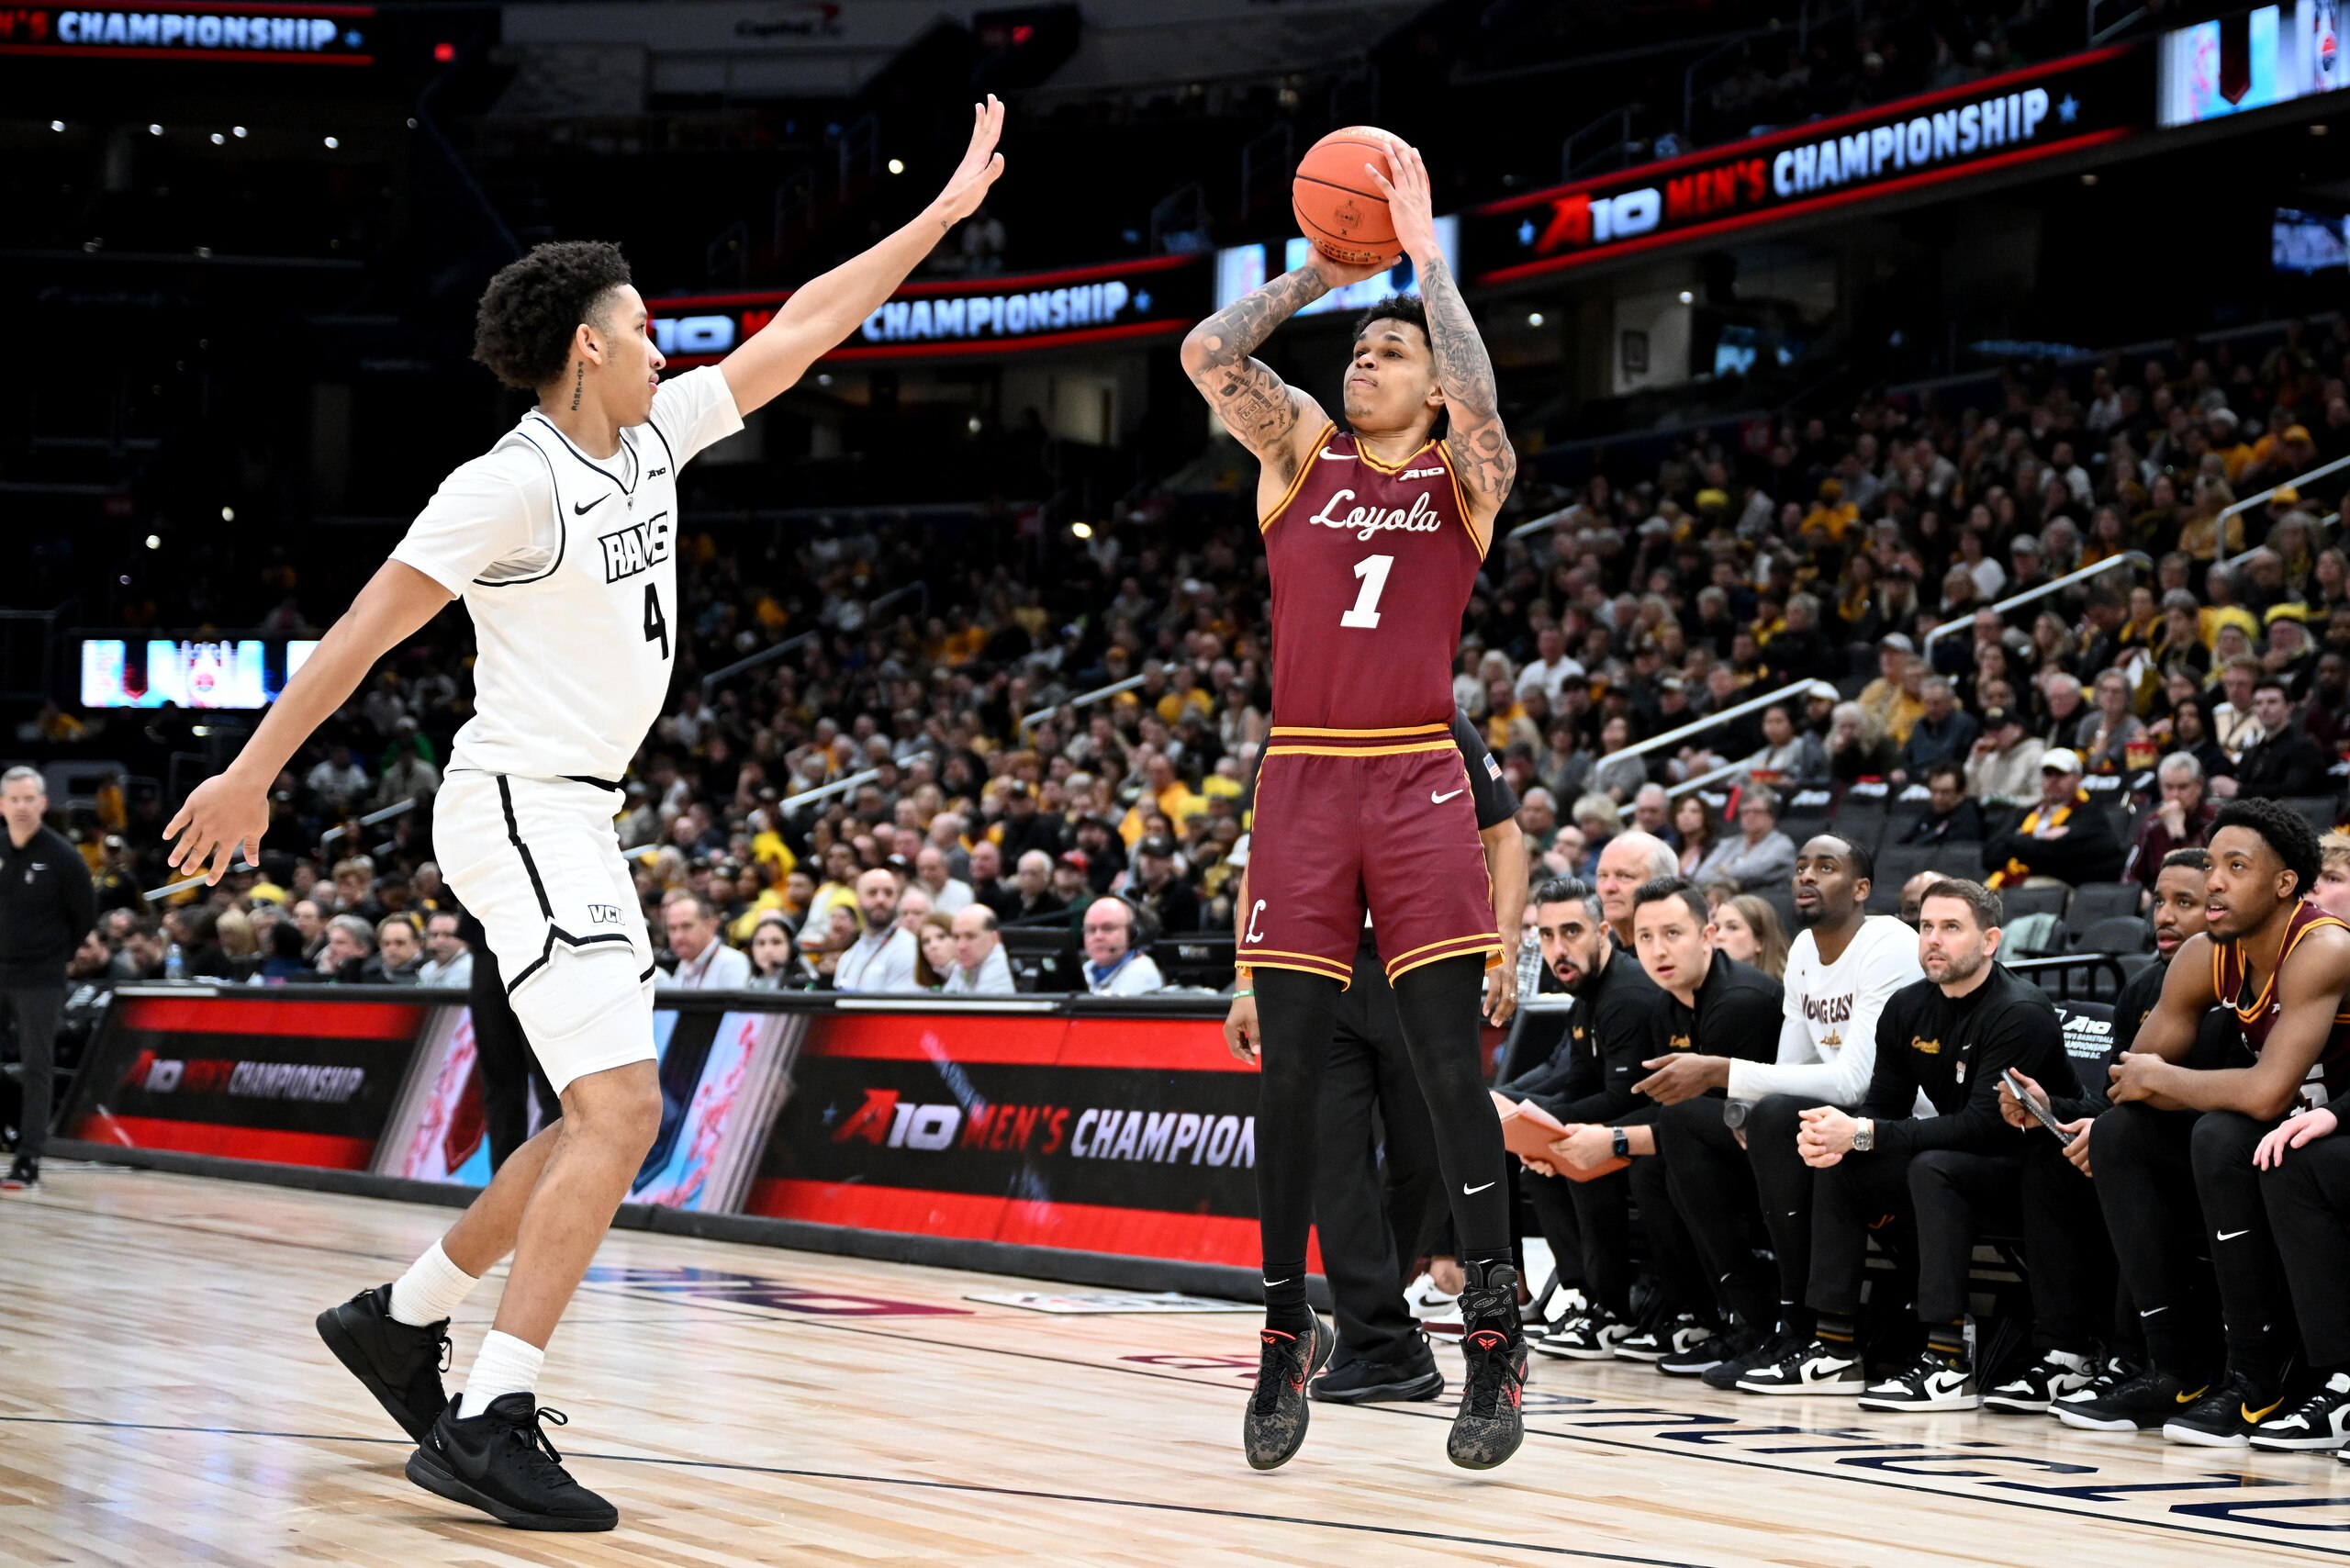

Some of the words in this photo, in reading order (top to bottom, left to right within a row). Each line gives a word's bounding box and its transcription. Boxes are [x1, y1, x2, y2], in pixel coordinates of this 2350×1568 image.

[57, 11, 337, 51] CHAMPIONSHIP
[1536, 187, 1662, 254] A10
[1666, 157, 1767, 220] MEN'S
[1774, 87, 2050, 198] CHAMPIONSHIP
[651, 315, 733, 355] 10
[861, 280, 1129, 342] CHAMPIONSHIP
[647, 466, 666, 480] A10
[1398, 466, 1446, 483] A10
[1310, 489, 1441, 542] Loyola
[597, 510, 669, 584] RAMS
[1340, 554, 1394, 629] 1
[643, 582, 669, 660] 4
[588, 904, 625, 926] VCU
[1246, 899, 1267, 944] L
[2062, 1015, 2112, 1035] A10
[2064, 1039, 2112, 1053] AMPIONSHIP
[229, 1059, 365, 1103] CHAMPIONSHIP
[832, 1088, 962, 1150] A10
[961, 1103, 1070, 1155] MEN'S
[1070, 1108, 1256, 1169] CHAMPION
